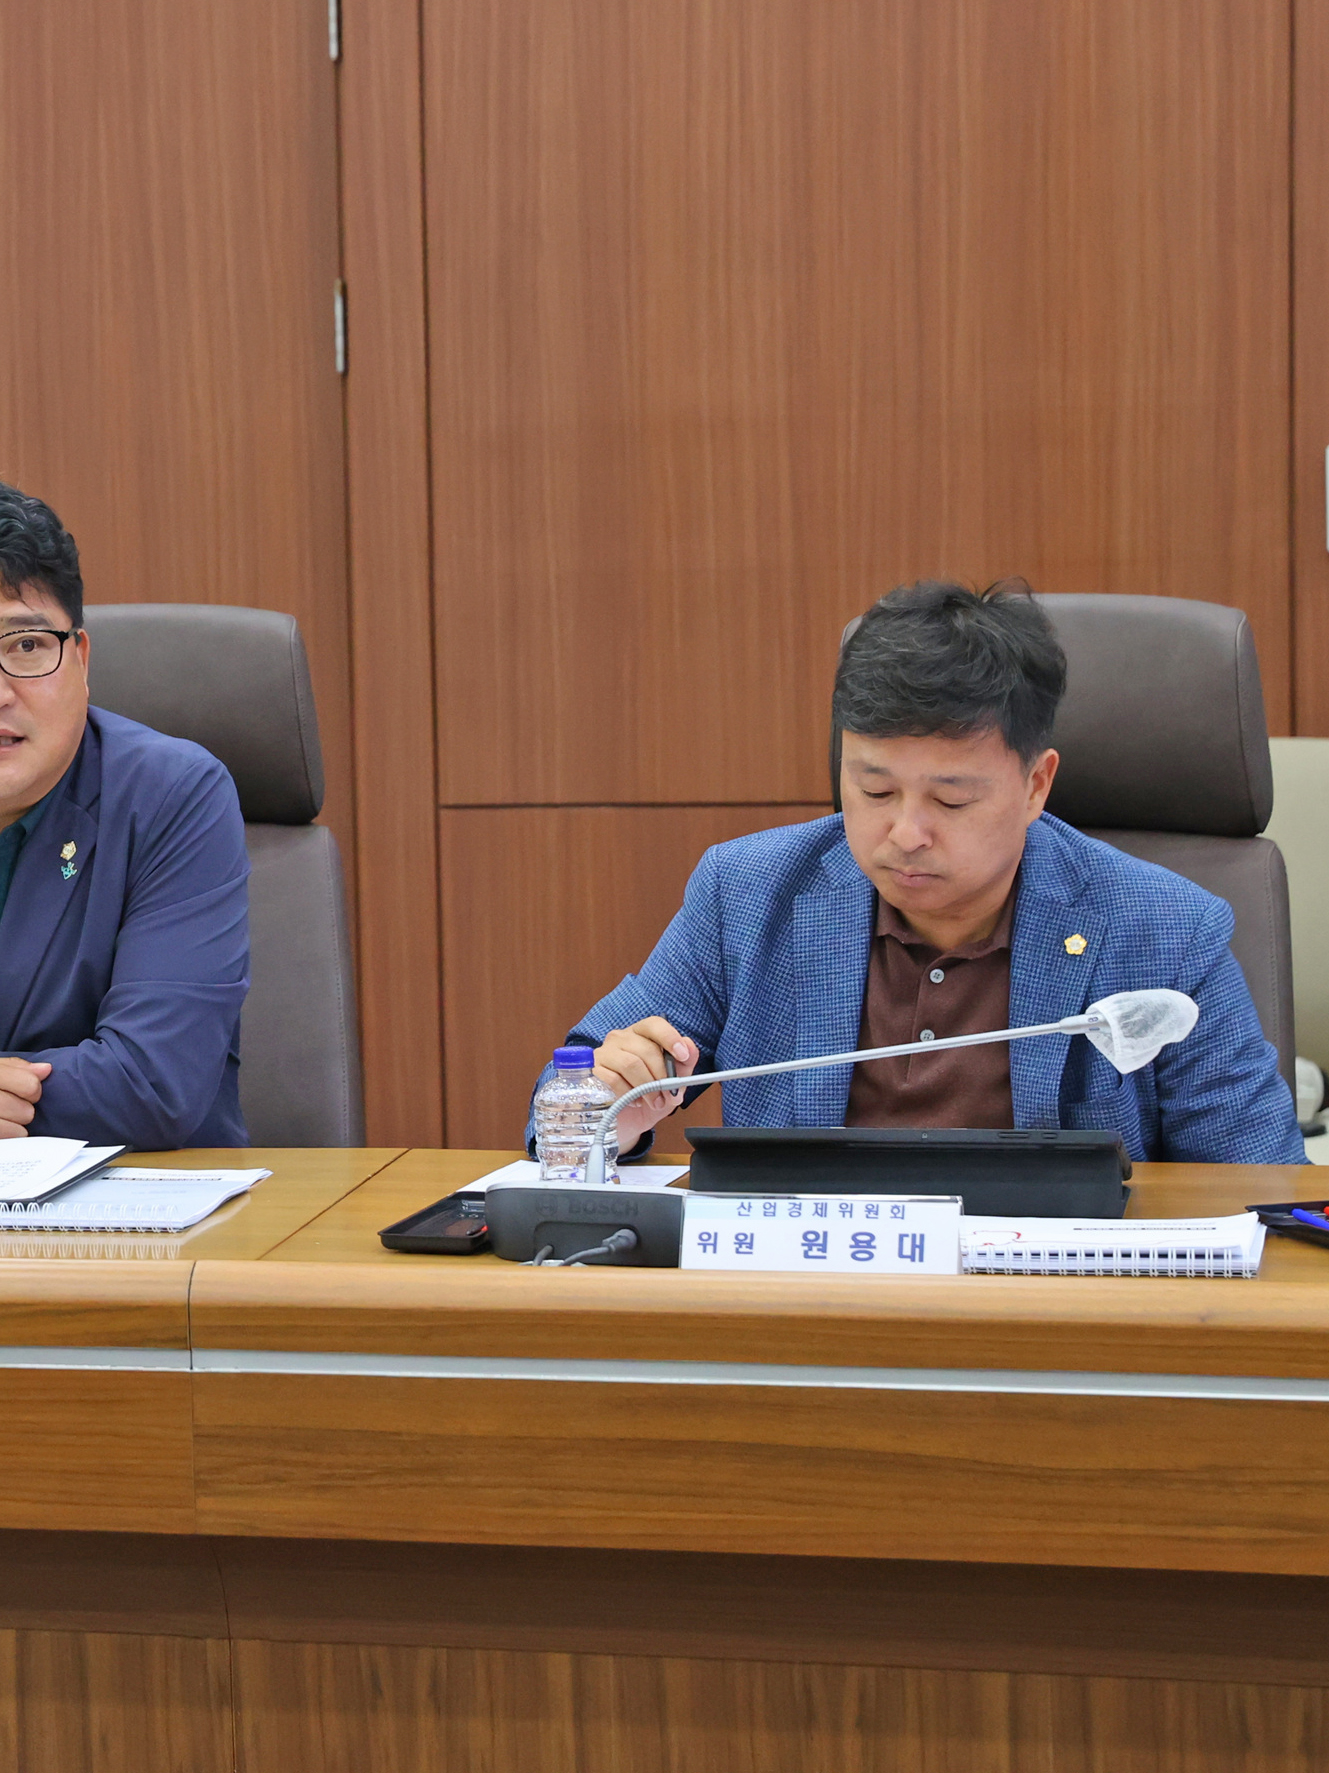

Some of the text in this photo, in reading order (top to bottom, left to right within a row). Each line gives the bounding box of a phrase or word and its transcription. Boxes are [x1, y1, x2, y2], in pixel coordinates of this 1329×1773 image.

[568, 1199, 640, 1217] BOSCH
[736, 1200, 906, 1221] 산업경제위원회
[696, 1229, 926, 1263] 위원 원용대
